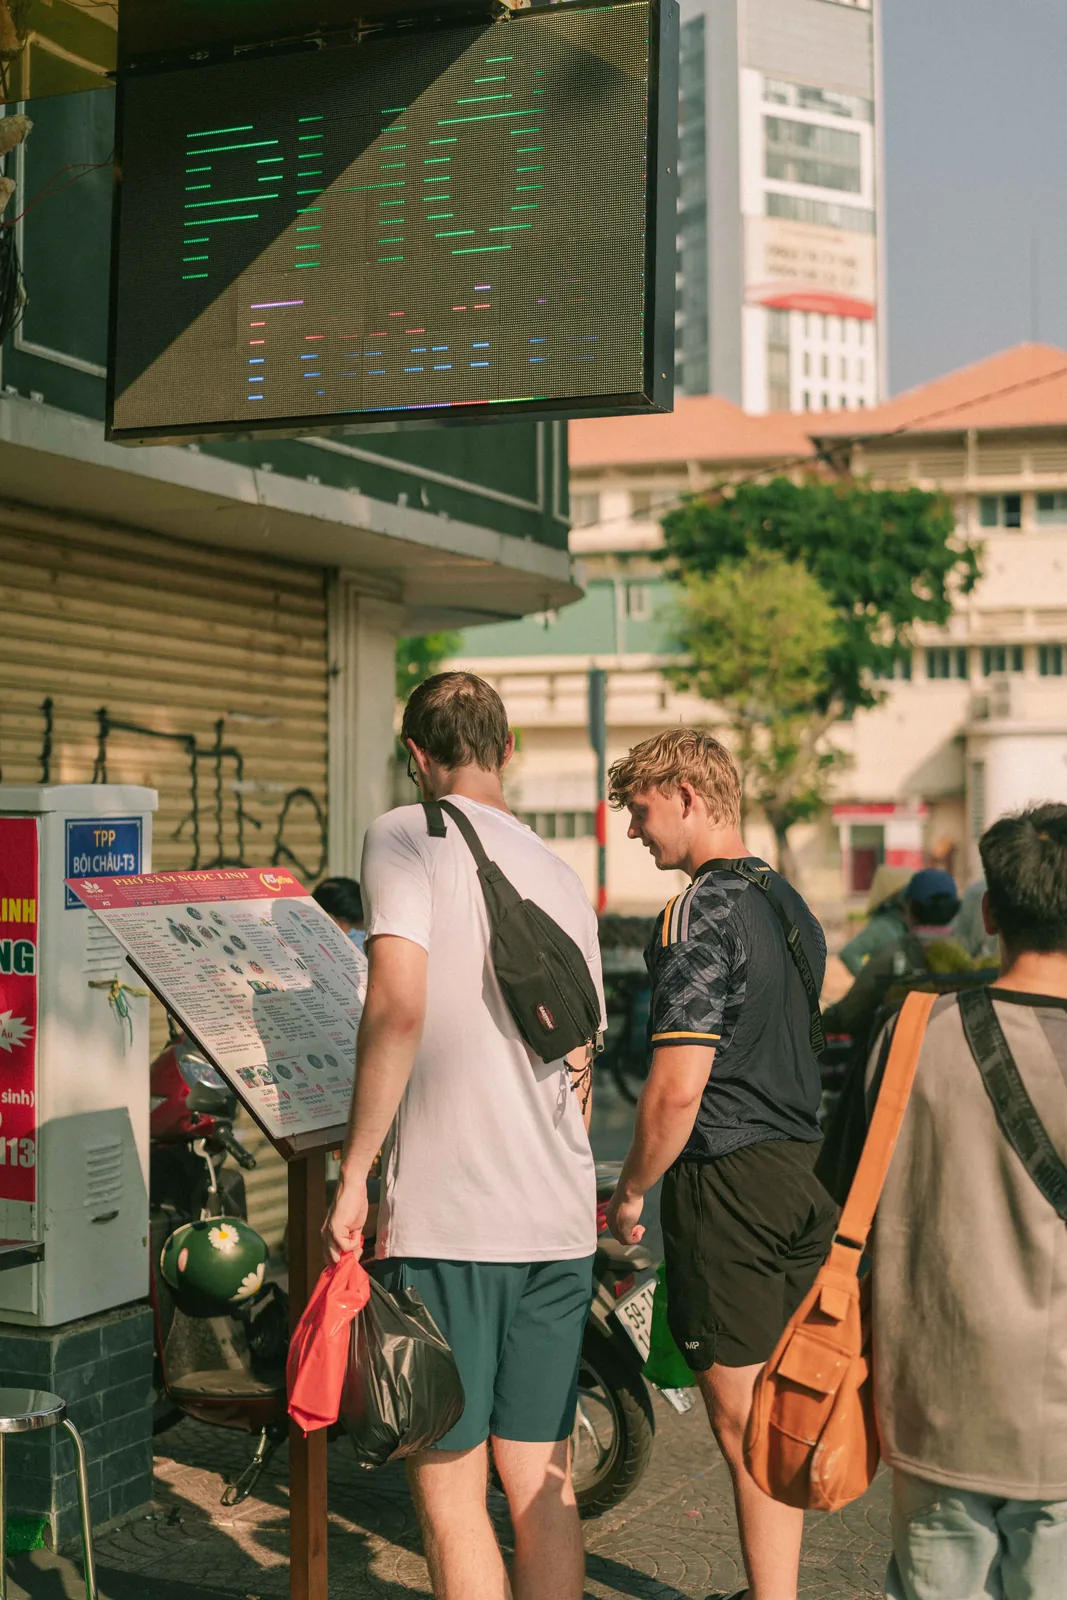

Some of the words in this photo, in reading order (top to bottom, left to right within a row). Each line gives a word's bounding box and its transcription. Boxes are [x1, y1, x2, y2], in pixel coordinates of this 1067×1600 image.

[93, 829, 117, 847] TPP
[92, 851, 135, 873] CHÂU-T3
[112, 875, 144, 887] PHỞ
[145, 873, 176, 884] SÂM
[177, 872, 216, 883] NGỌC
[217, 870, 249, 880] LINH
[0, 897, 36, 923] INH
[1, 1088, 35, 1108] sinh)
